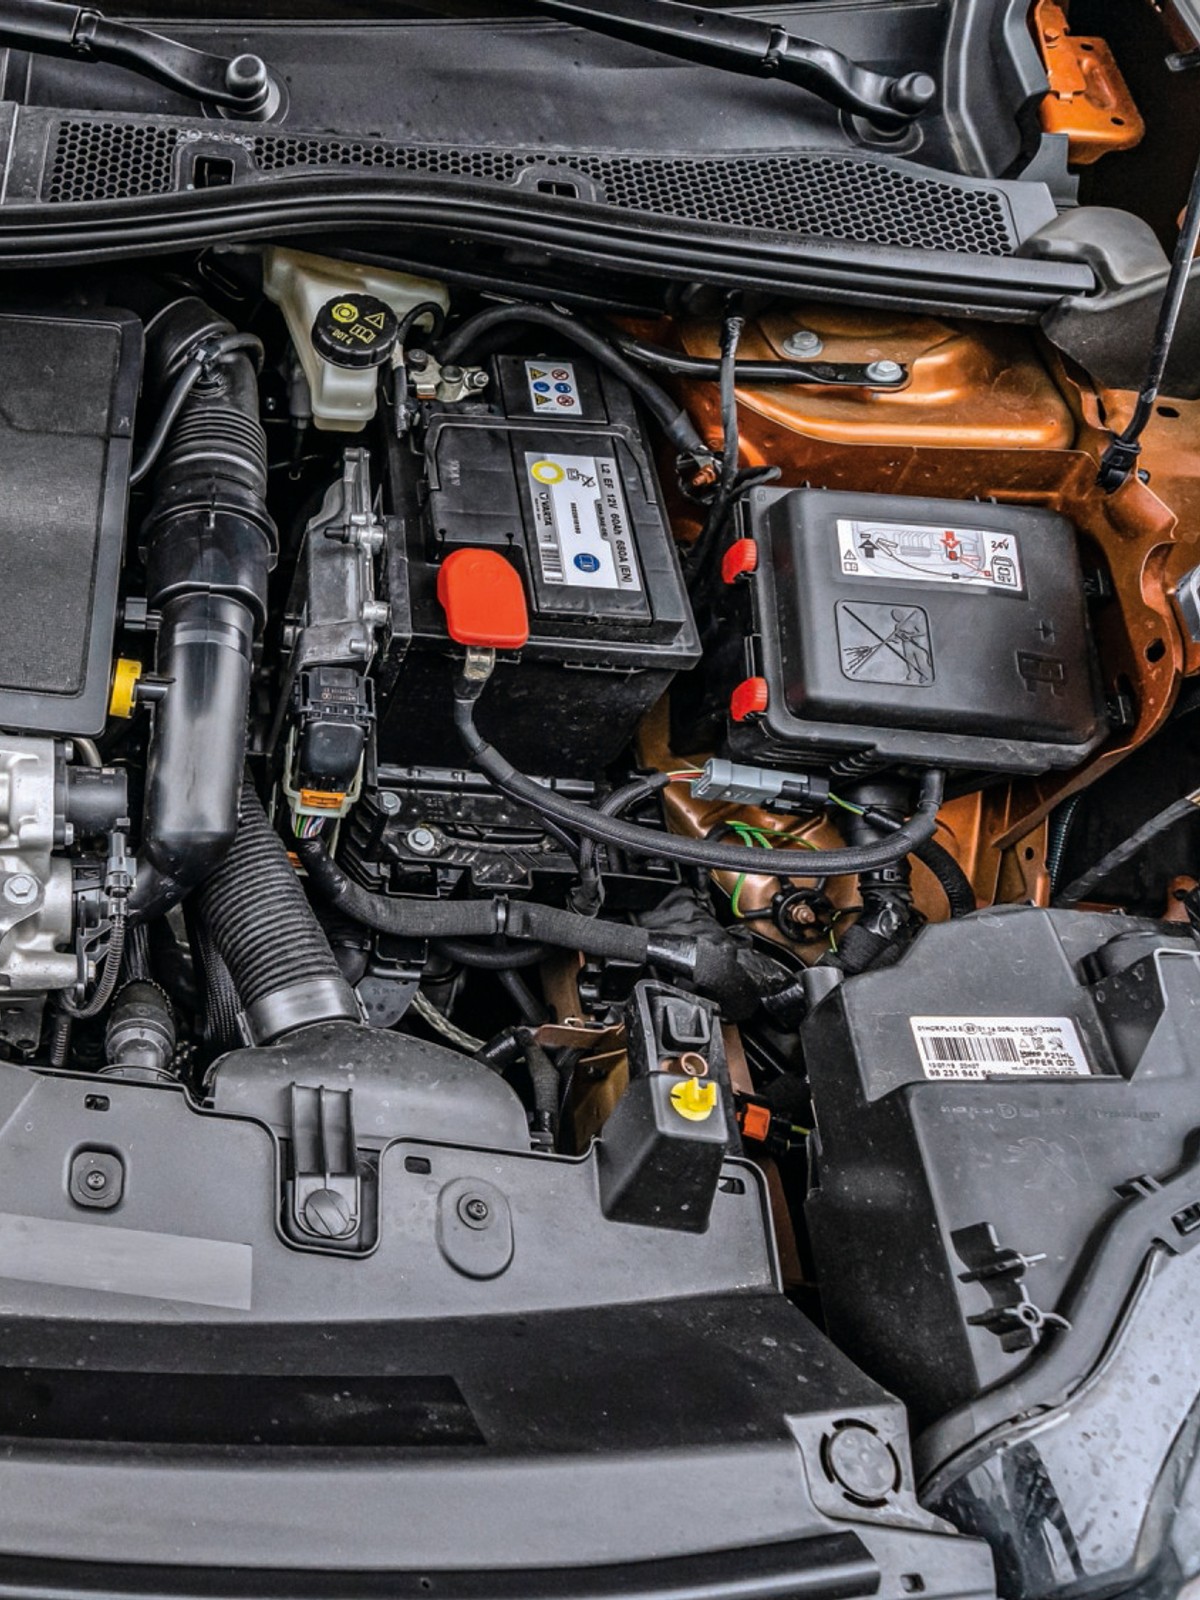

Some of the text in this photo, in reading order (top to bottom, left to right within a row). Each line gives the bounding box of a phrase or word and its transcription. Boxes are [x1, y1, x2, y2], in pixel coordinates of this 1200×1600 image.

[332, 328, 349, 341] DOT
[607, 494, 618, 510] 12V
[540, 500, 553, 527] VARTA
[610, 513, 623, 535] 60Ah
